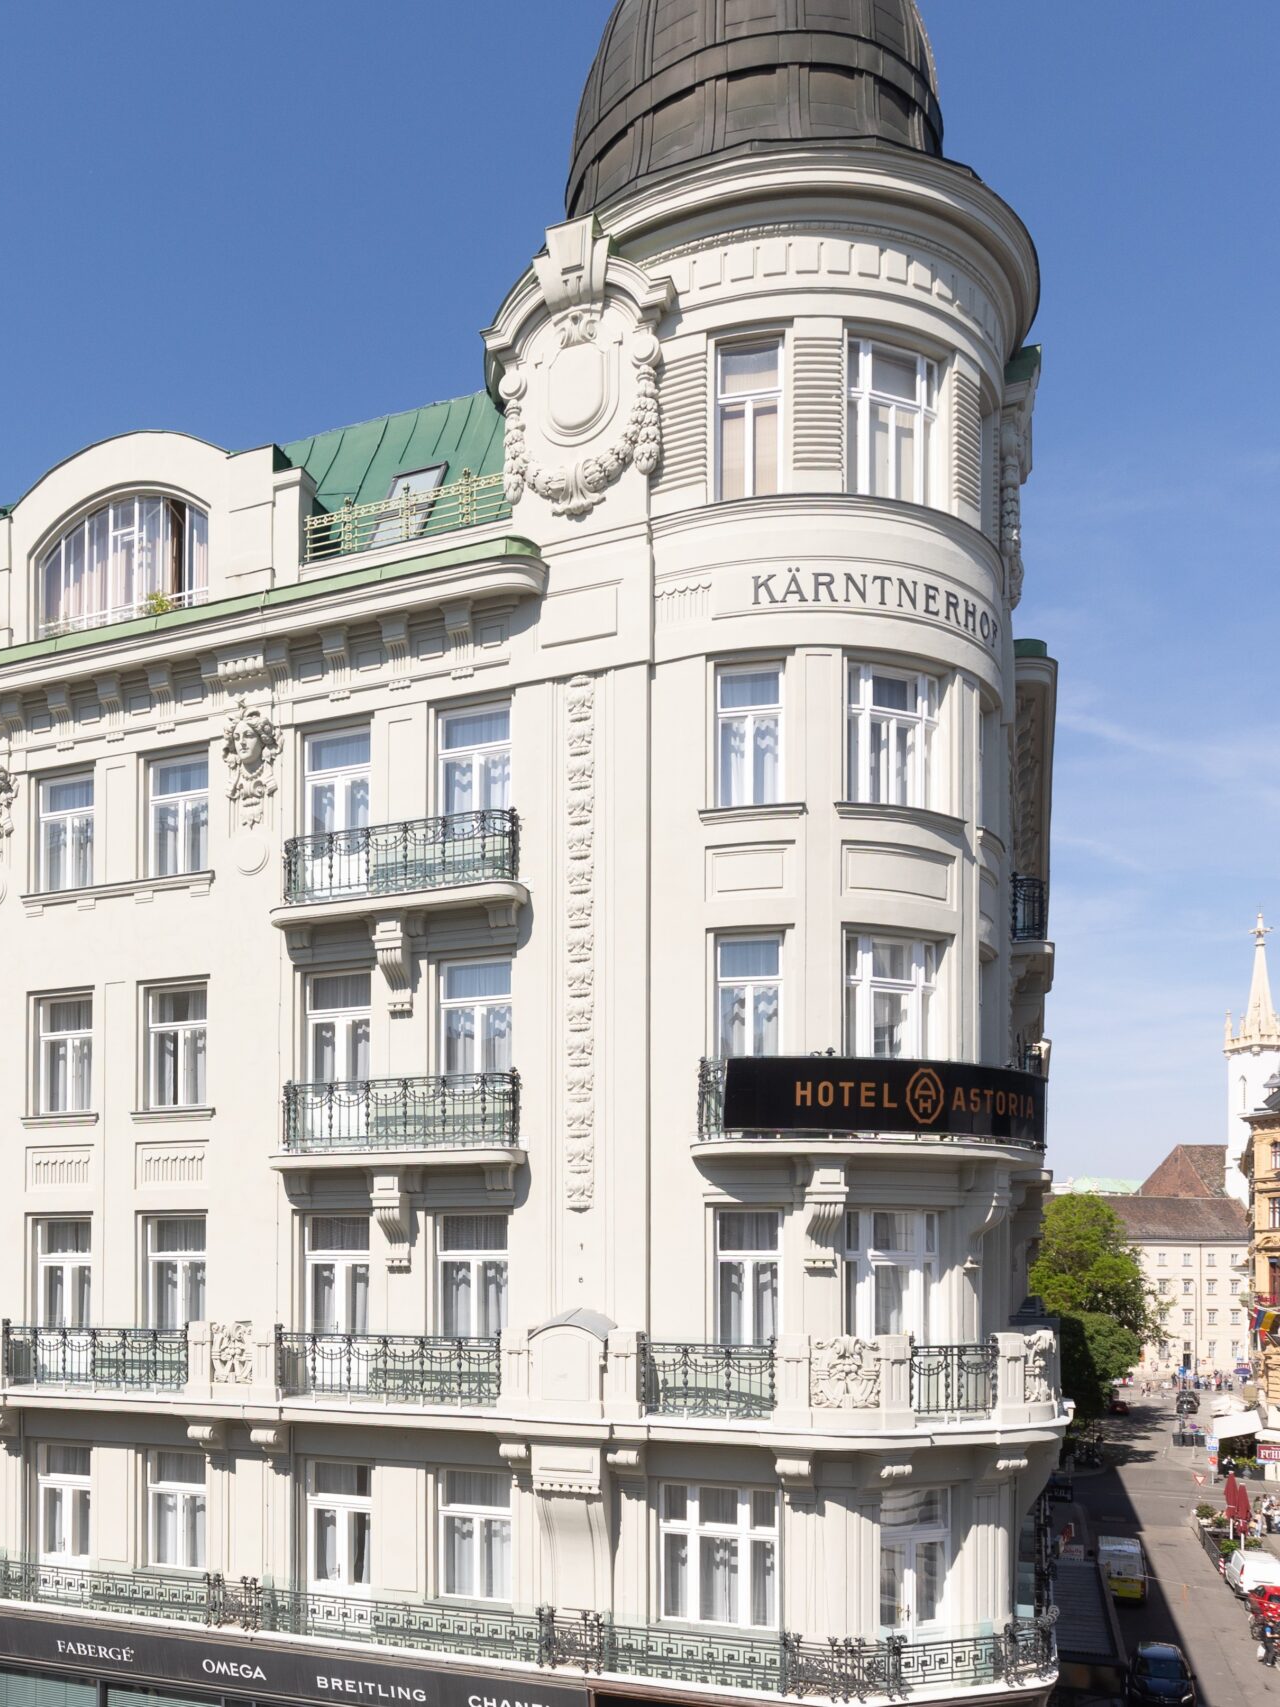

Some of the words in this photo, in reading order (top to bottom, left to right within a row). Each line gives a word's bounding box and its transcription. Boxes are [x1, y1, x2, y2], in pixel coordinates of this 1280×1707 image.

[751, 567, 999, 648] KÄRNTNERHOF
[795, 1081, 898, 1109] HOTEL
[952, 1086, 1035, 1120] ASTORIA
[56, 1640, 134, 1662] FABERGÉ
[202, 1658, 267, 1681] OMEGA
[316, 1675, 427, 1703] BREITLING
